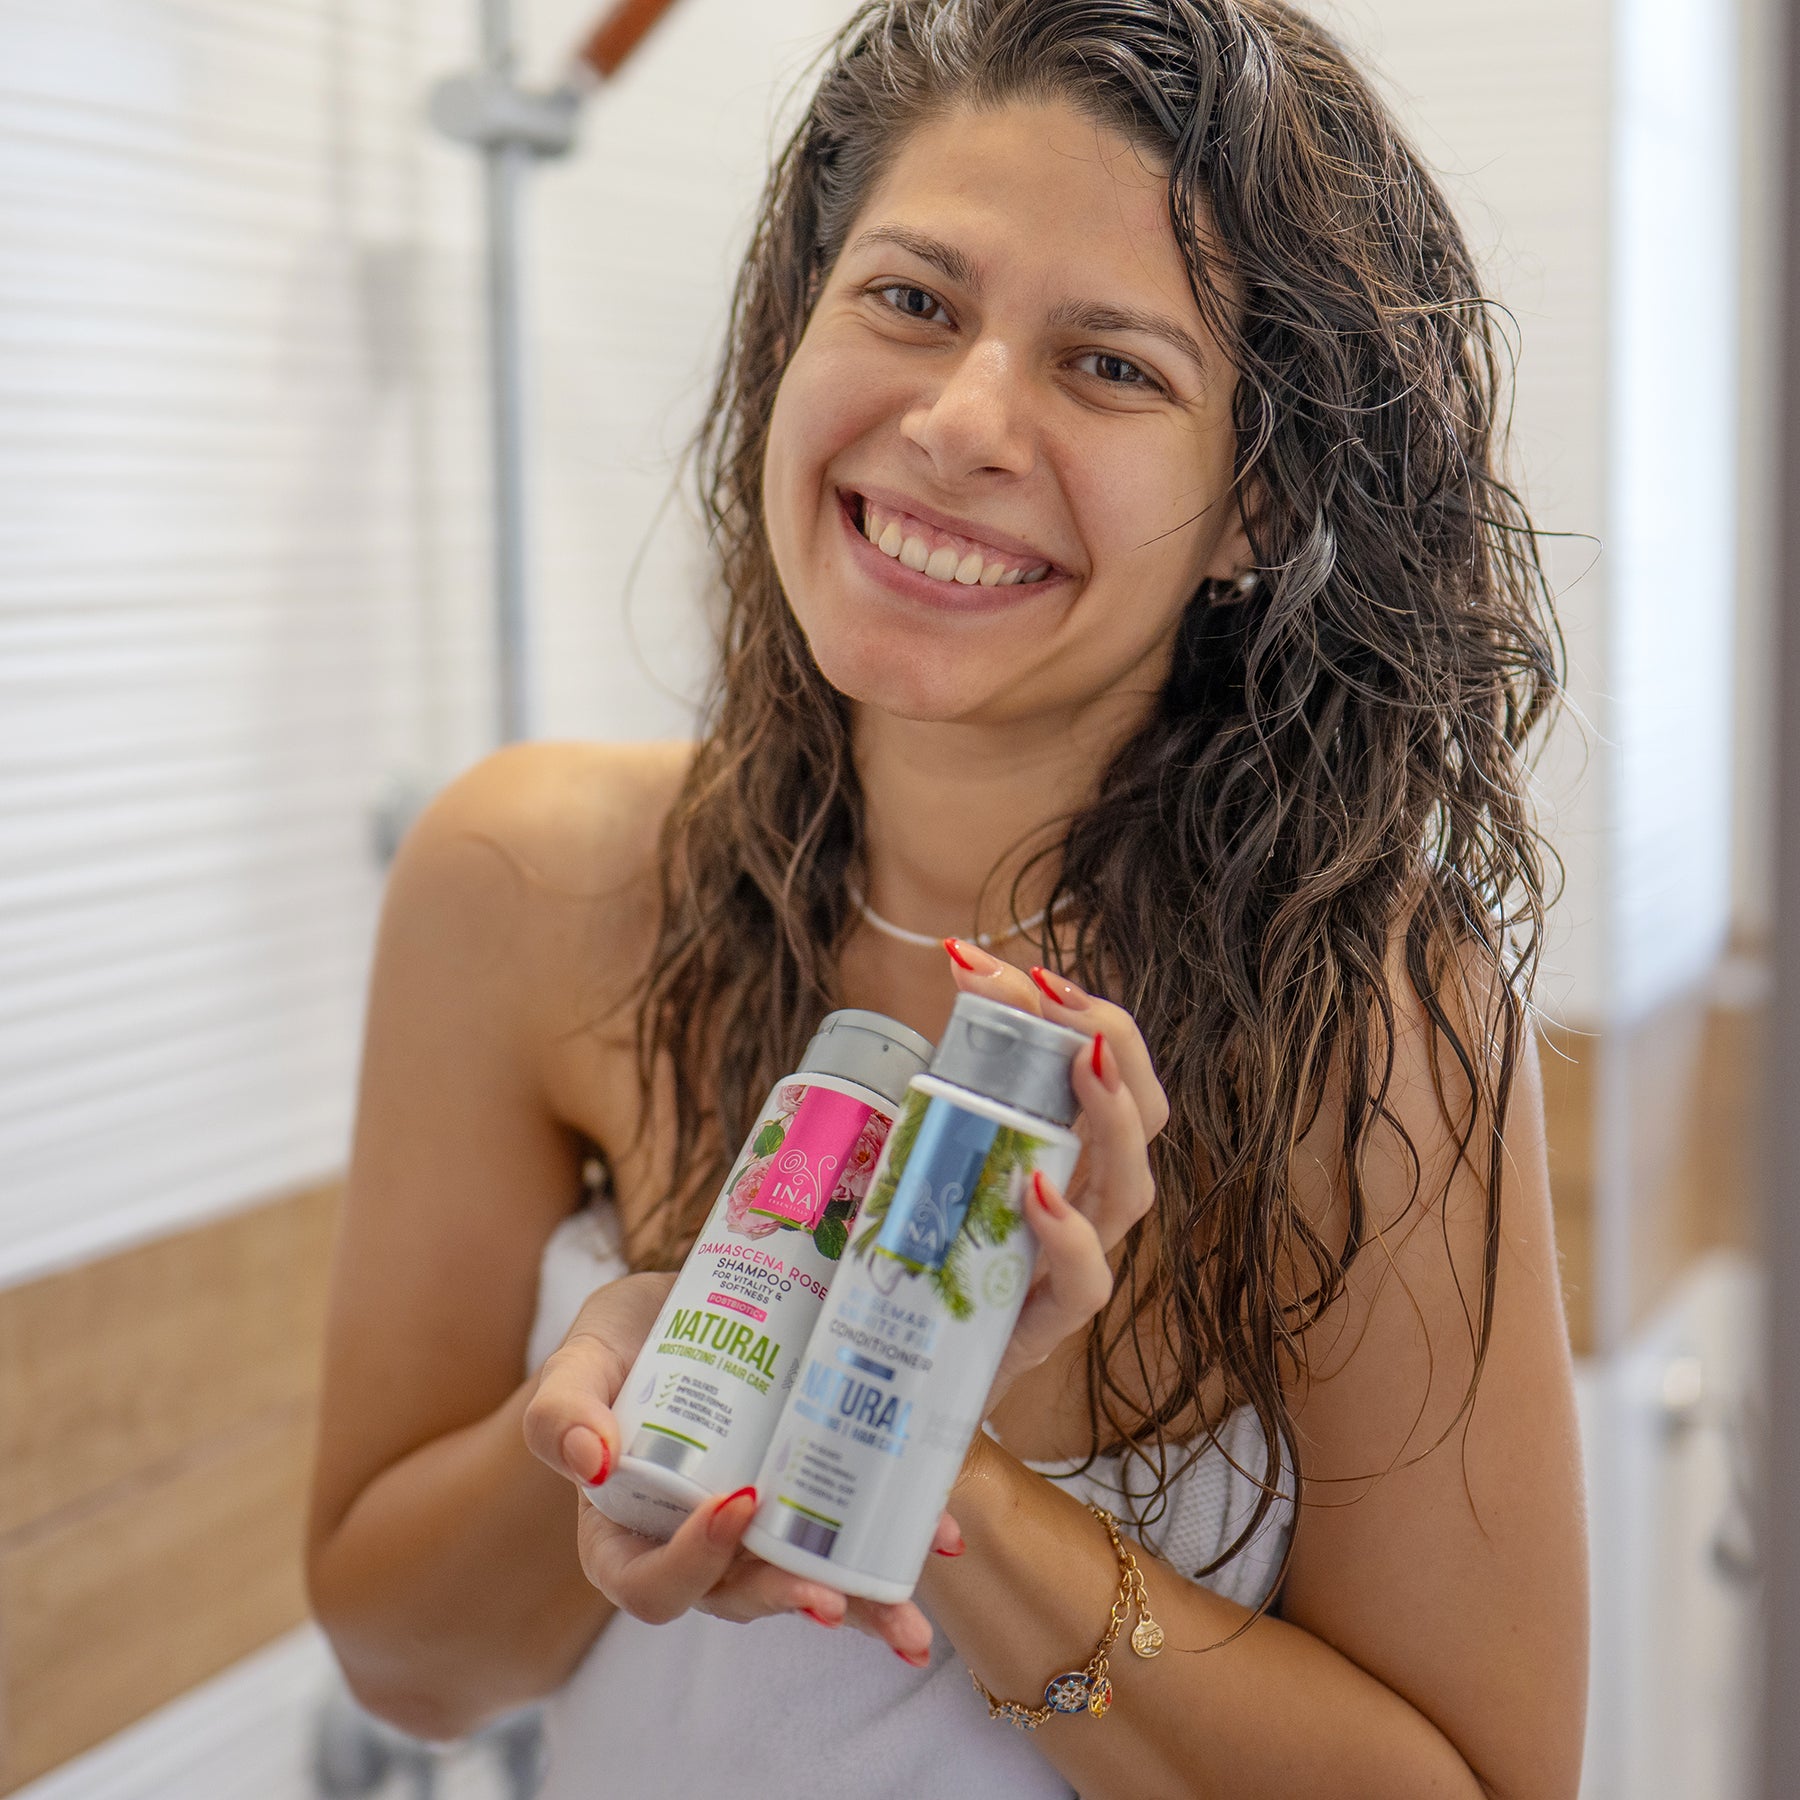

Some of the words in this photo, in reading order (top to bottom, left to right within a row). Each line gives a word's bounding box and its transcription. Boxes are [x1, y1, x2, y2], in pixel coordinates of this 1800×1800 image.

[771, 1181, 812, 1211] INA
[697, 1242, 785, 1273] DAMASCENA
[788, 1266, 828, 1302] ROSE
[711, 1269, 733, 1282] FOR
[733, 1275, 775, 1296] VITALITY
[774, 1292, 784, 1303] &
[716, 1257, 792, 1293] SHAMPOO
[719, 1280, 770, 1305] SOFTNESS
[664, 1308, 782, 1381] NATURAL
[830, 1318, 934, 1371] CONDITIONER
[656, 1343, 717, 1367] MOISTURIZING
[723, 1360, 749, 1380] HAIR
[748, 1373, 772, 1395] CARE
